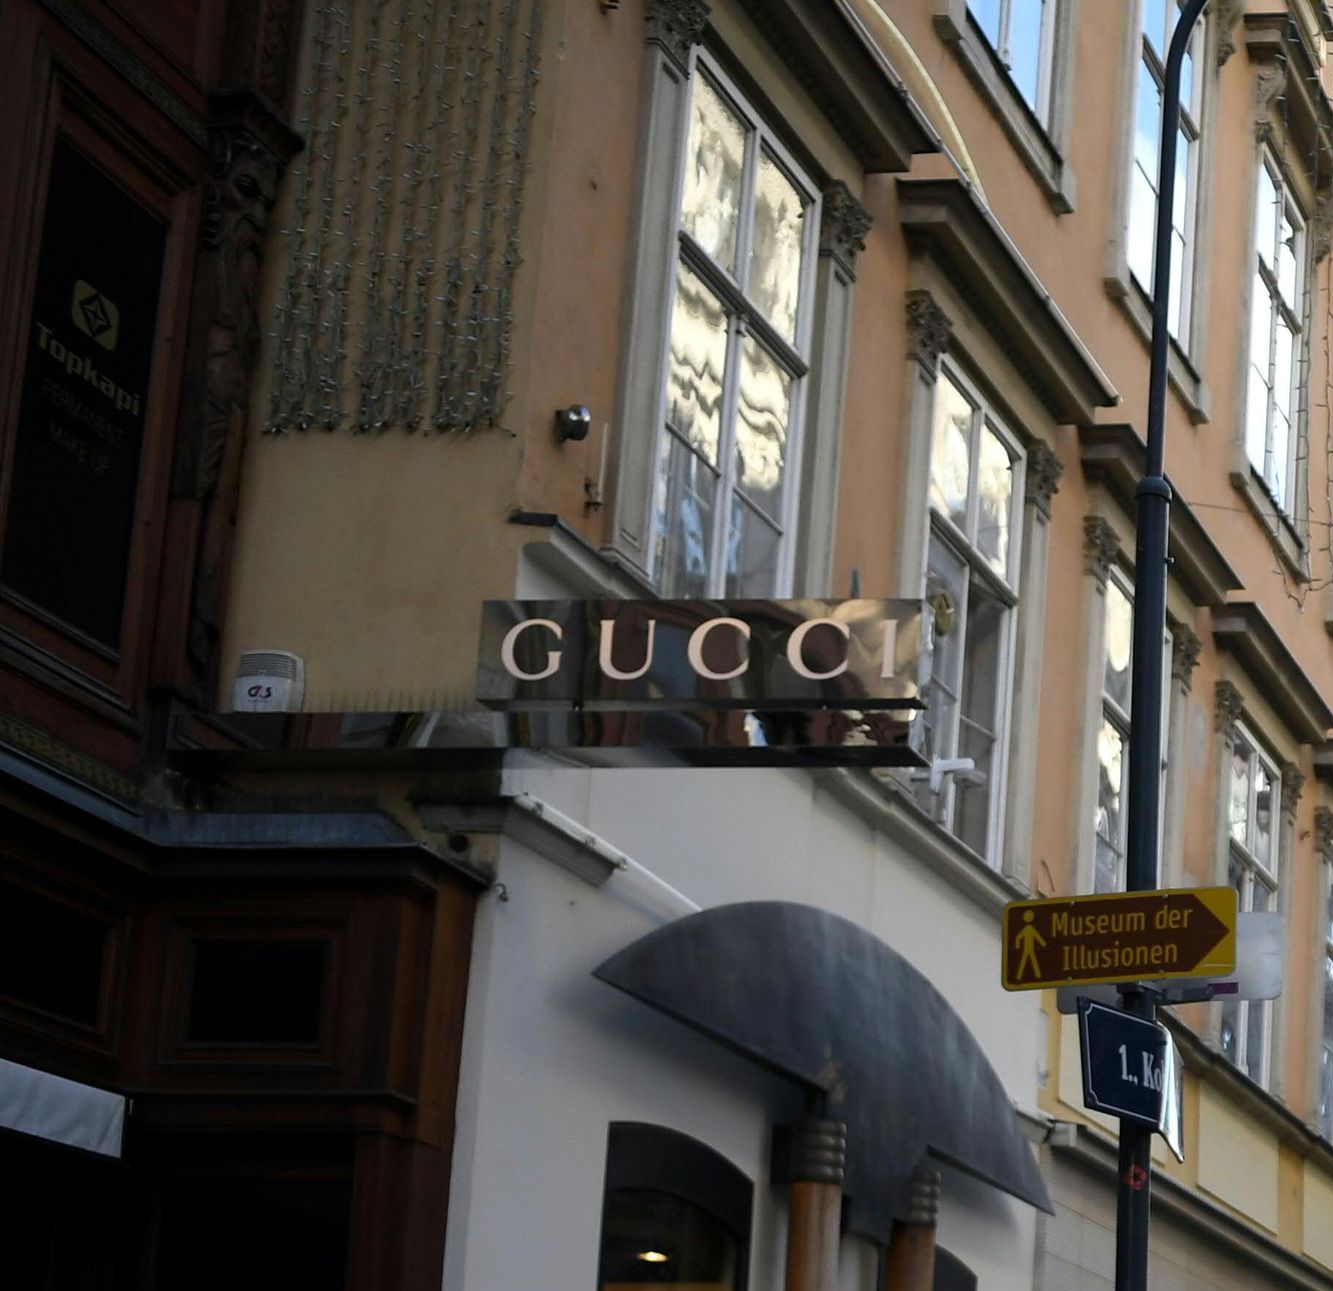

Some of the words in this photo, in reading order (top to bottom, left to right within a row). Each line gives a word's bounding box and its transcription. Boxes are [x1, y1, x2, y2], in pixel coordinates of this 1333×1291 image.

[33, 318, 141, 417] Topkapi
[501, 617, 897, 680] GUCCI
[1052, 911, 1145, 938] Museum
[1155, 904, 1193, 930] der
[1063, 941, 1178, 972] Illusionen
